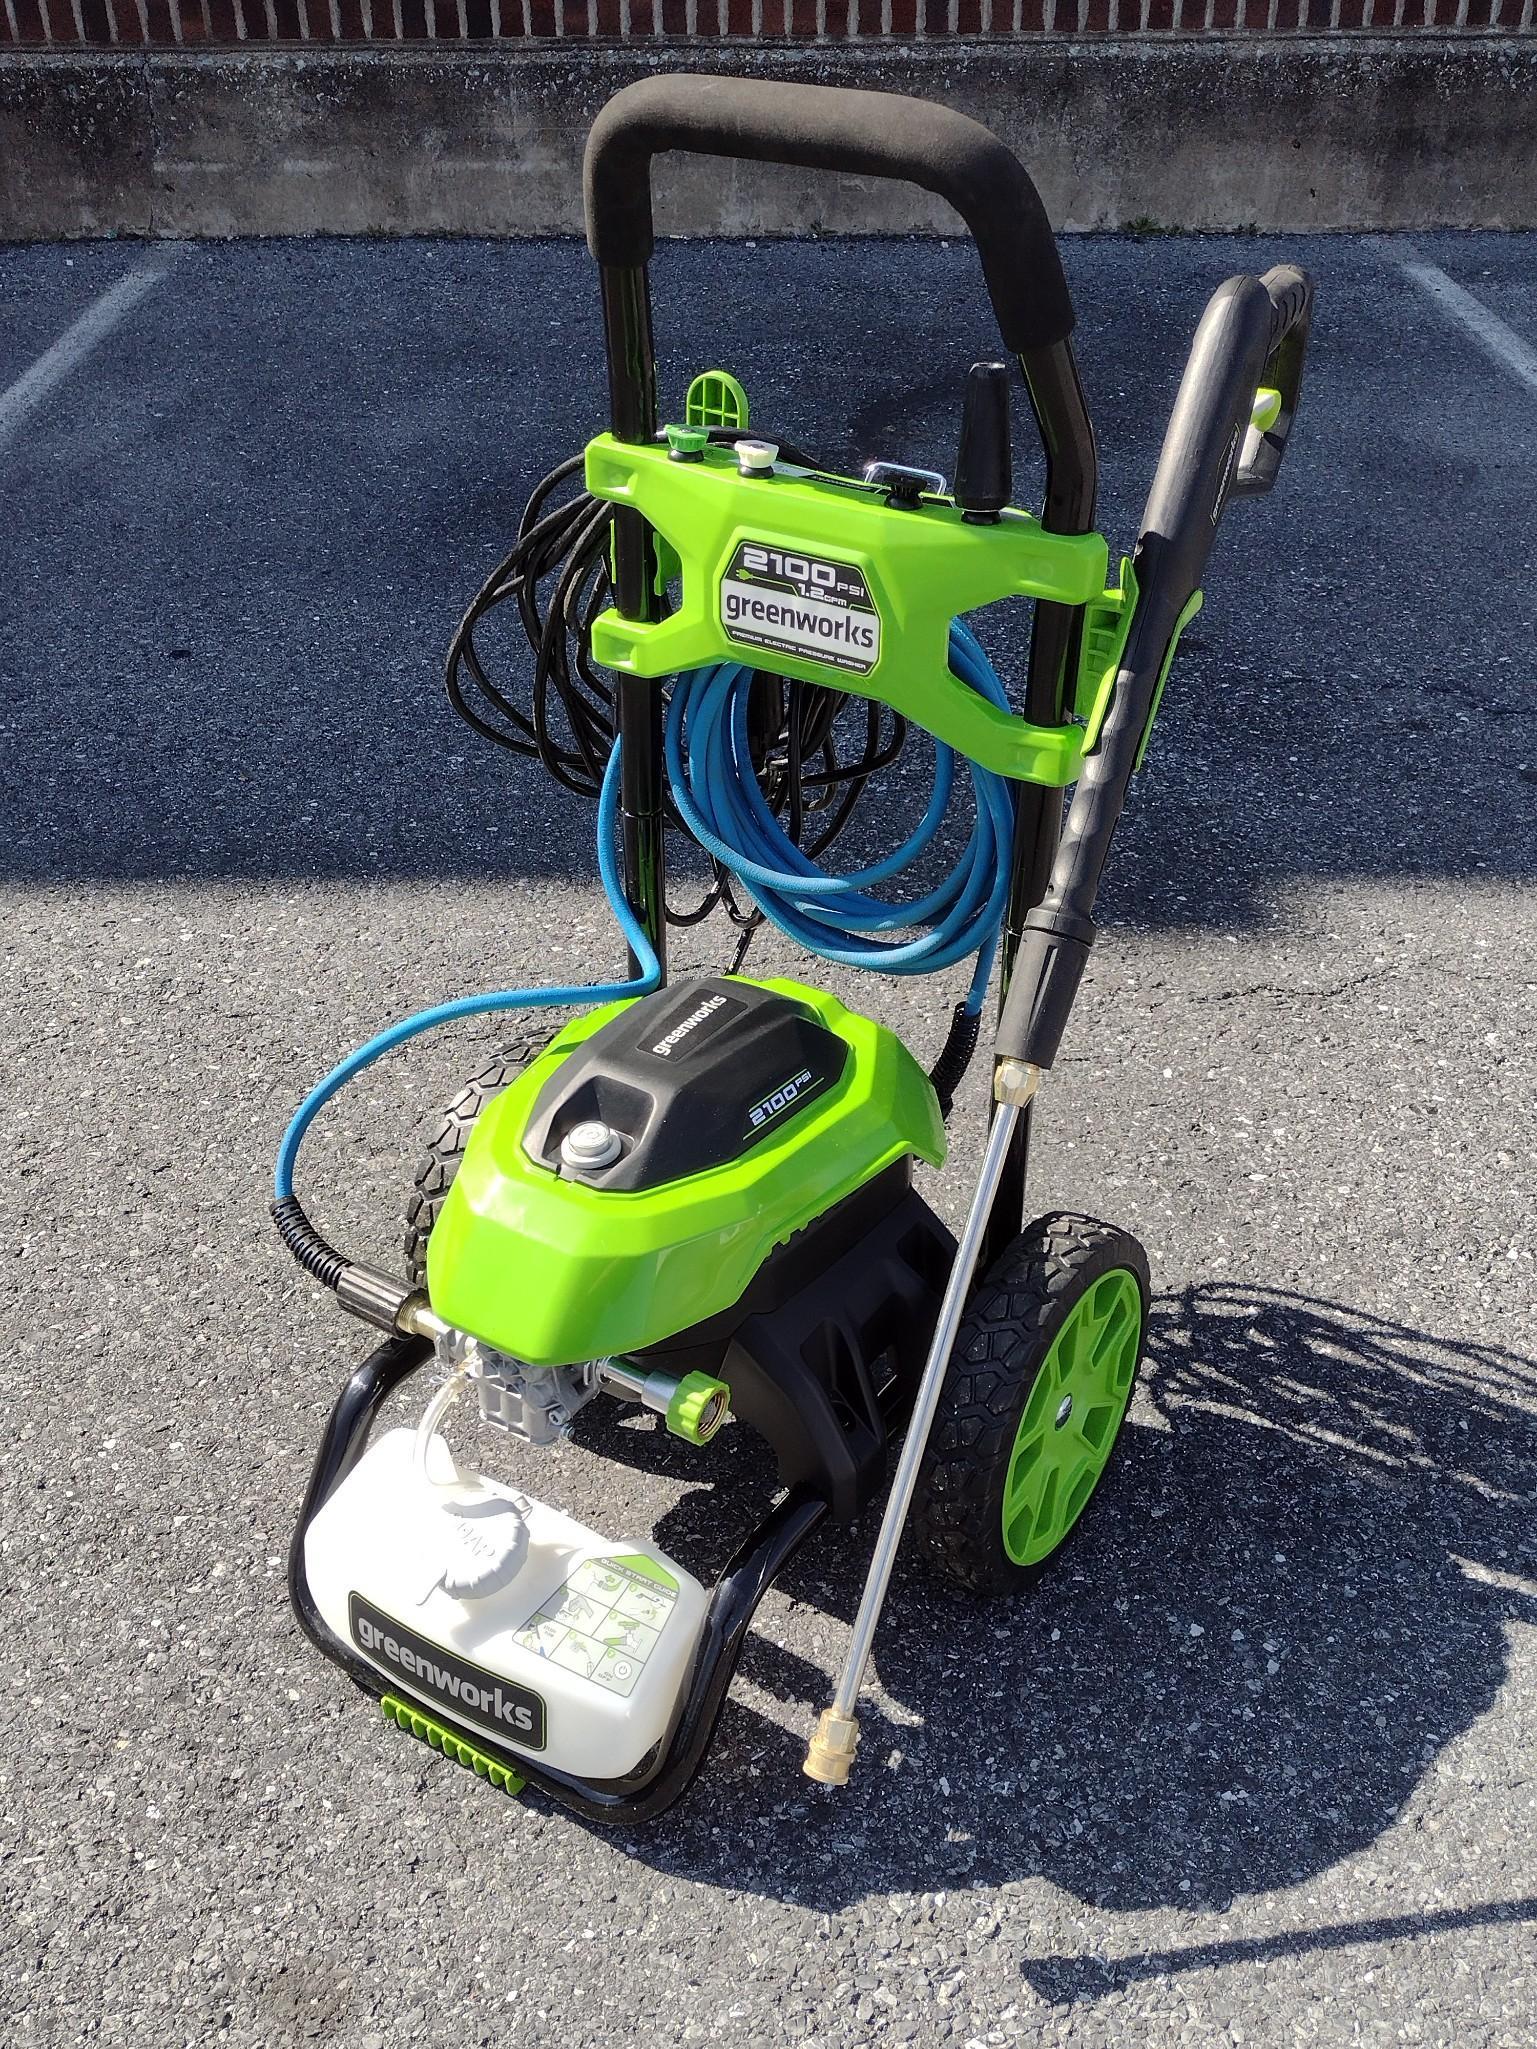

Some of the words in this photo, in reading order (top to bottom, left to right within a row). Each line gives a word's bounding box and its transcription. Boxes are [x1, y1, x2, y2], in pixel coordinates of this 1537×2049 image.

[743, 547, 836, 588] 2100
[837, 583, 864, 597] PSI
[726, 594, 874, 649] greenworks
[652, 995, 728, 1057] greenworks
[749, 1083, 798, 1126] 2100
[794, 1071, 812, 1087] PSI
[601, 1558, 625, 1573] QUICK
[624, 1570, 652, 1586] START
[358, 1617, 533, 1731] greenworks
